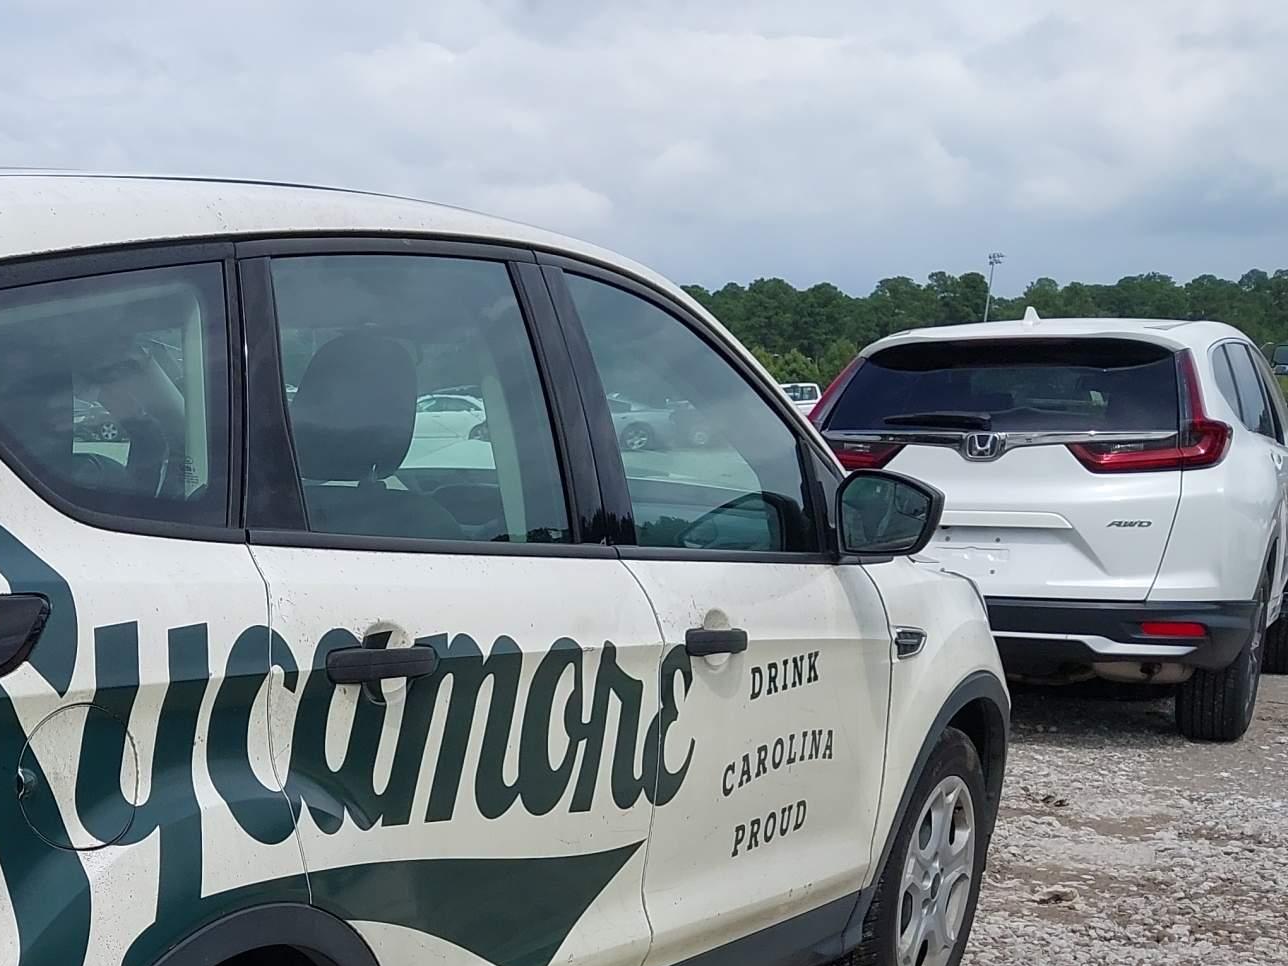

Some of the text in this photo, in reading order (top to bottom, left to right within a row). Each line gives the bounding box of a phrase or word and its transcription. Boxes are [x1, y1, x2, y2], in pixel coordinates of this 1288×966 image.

[1106, 520, 1153, 528] AWD
[749, 651, 820, 700] DRINK
[722, 729, 834, 797] CAROLINA
[731, 799, 807, 858] PROUD
